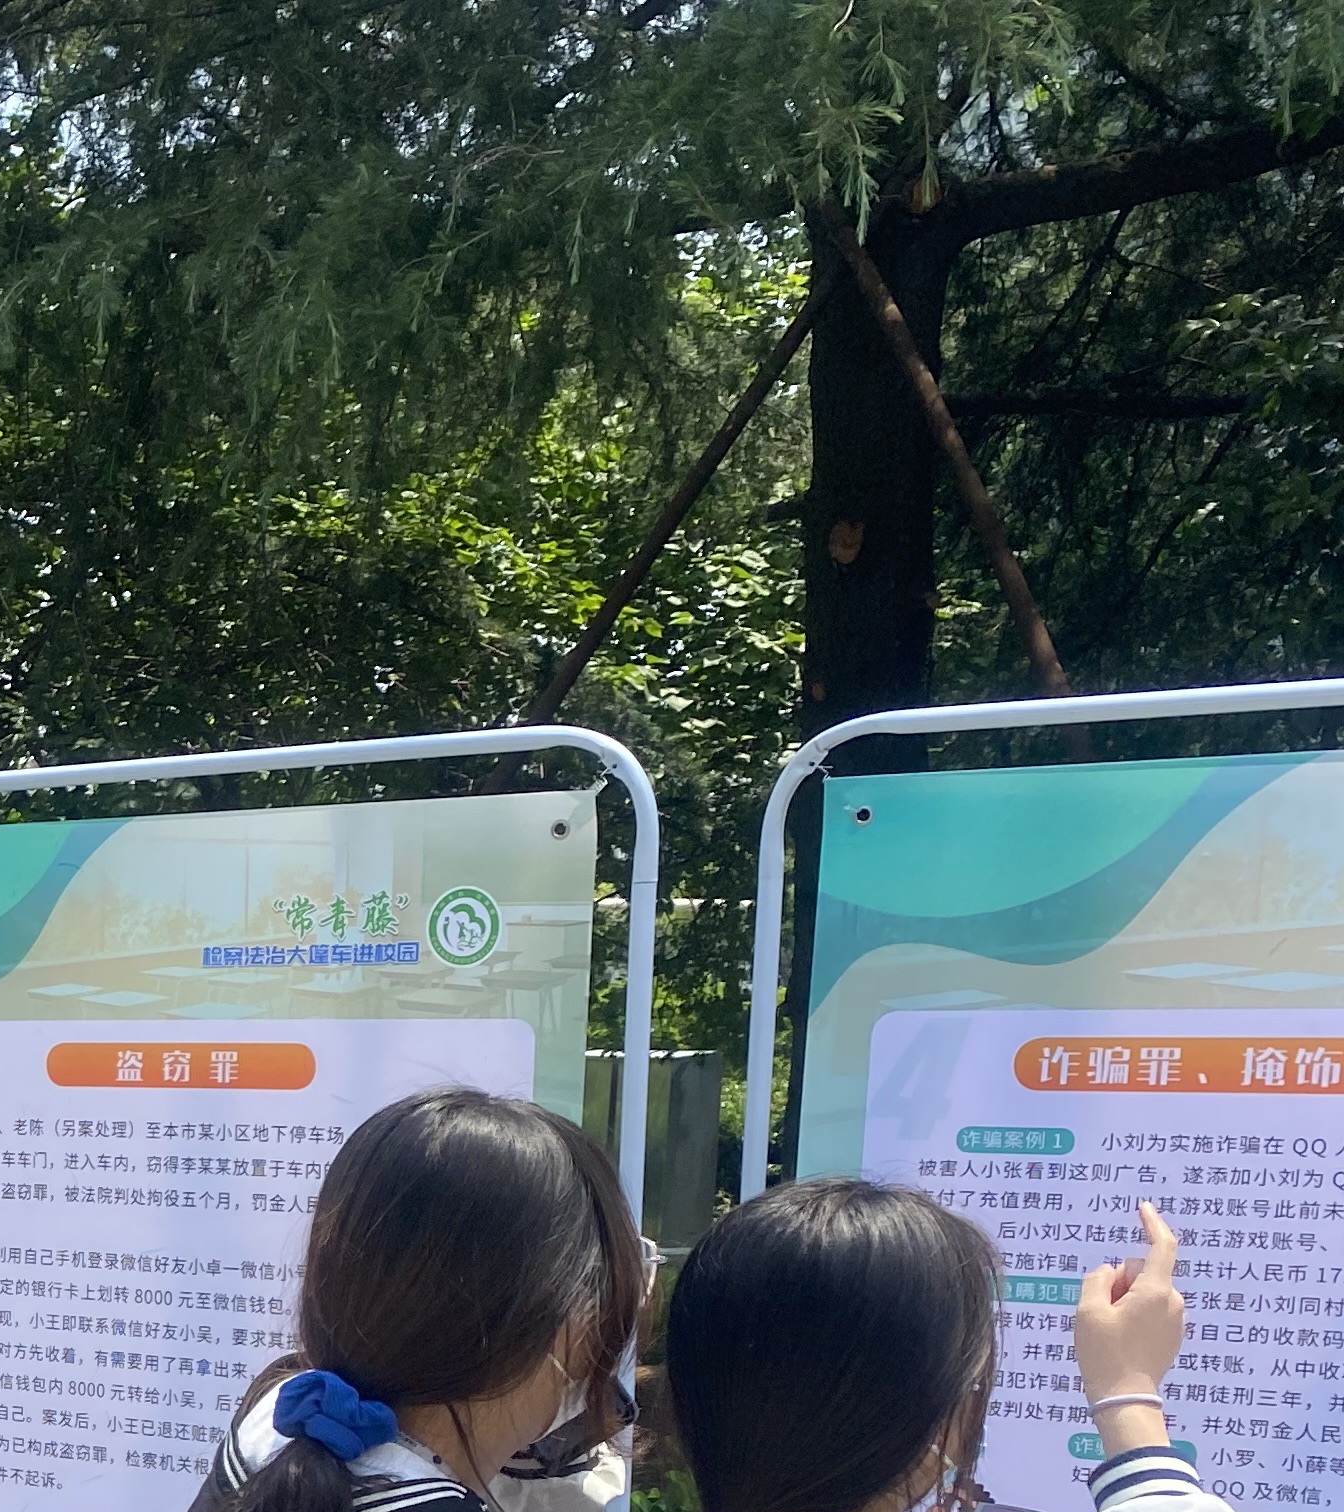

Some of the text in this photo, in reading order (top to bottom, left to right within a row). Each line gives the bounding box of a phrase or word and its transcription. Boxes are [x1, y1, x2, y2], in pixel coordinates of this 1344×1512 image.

[115, 1050, 241, 1084] 盗窃罪
[1038, 1046, 1344, 1090] 诈骗罪、掩饰
[997, 1221, 1328, 1252] 后小刘又陆续编激活游戏账号、
[987, 1401, 1095, 1425] 被判处有期
[1199, 1478, 1333, 1507] QQ及微信，
